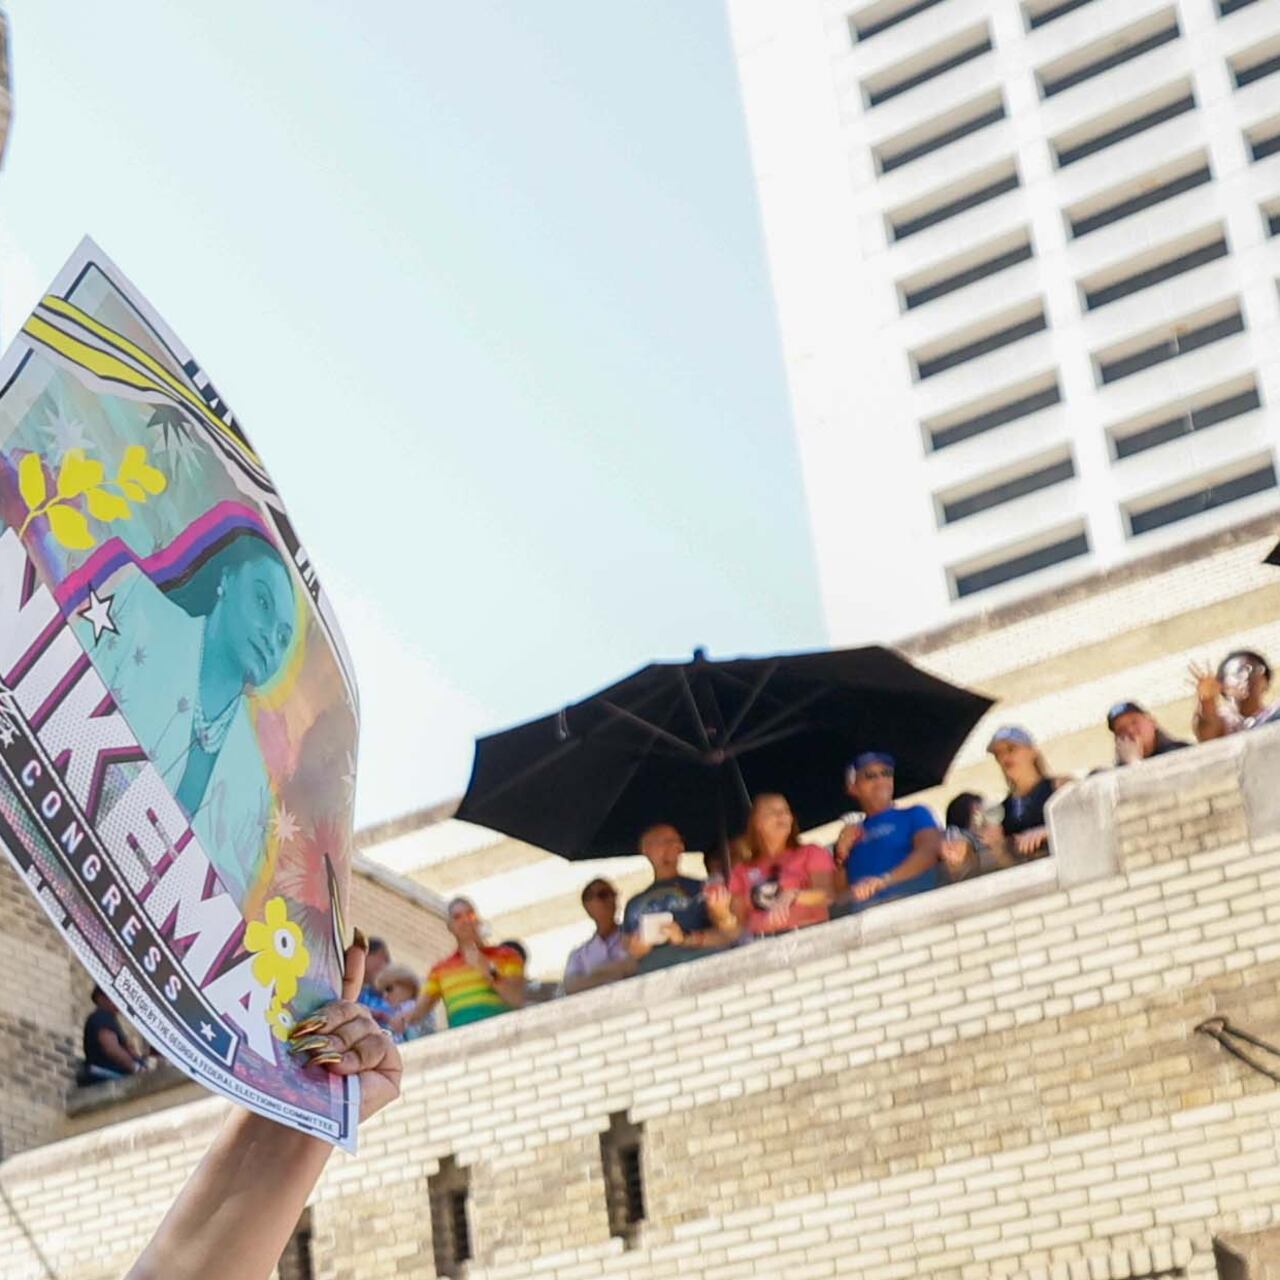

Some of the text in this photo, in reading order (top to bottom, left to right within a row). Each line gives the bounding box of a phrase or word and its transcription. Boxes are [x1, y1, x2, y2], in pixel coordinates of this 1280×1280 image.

[21, 759, 182, 1001] CONGRESS
[197, 1058, 236, 1089] FEDERAL
[281, 1102, 335, 1132] COMMITTEE
